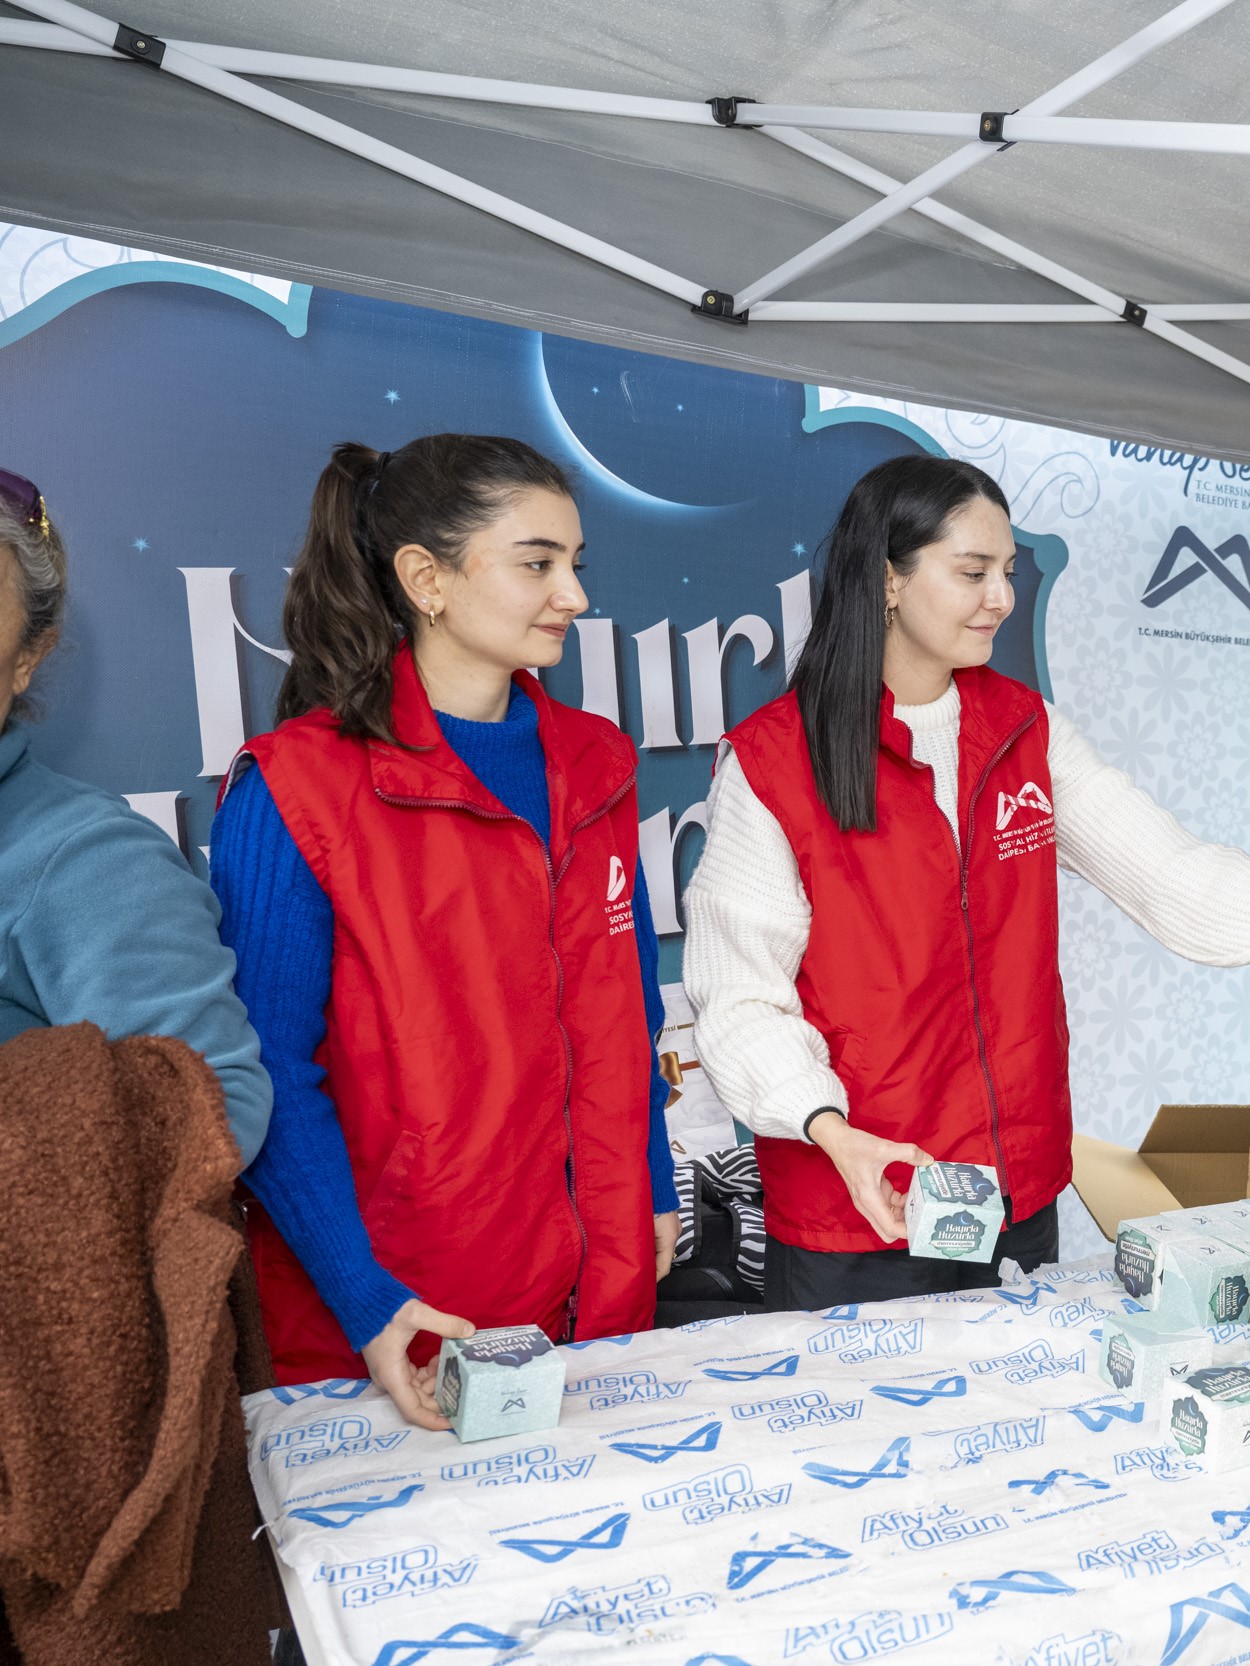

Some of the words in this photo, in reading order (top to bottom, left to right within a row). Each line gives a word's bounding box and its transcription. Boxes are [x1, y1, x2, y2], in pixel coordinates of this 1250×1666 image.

[1195, 493, 1239, 509] BELEDİYE
[1196, 479, 1214, 493] T.C.
[1215, 483, 1250, 498] MERSİN
[1138, 627, 1150, 636] T.C.
[1153, 629, 1183, 640] MERSİN
[1185, 631, 1232, 645] BÜYÜKŞEHİR
[938, 1231, 975, 1240] Huzurla
[945, 1223, 979, 1234] Hayırla
[473, 1333, 538, 1350] Huzurla
[474, 1341, 533, 1358] Hayırla
[811, 1319, 890, 1354] Olsun
[842, 1319, 921, 1363] Afiyet
[972, 1341, 1051, 1373] Olsun
[1007, 1353, 1082, 1383] Afiyet
[565, 1372, 656, 1394] Olsun
[1203, 1369, 1247, 1387] Hayırla
[595, 1380, 687, 1410] Afiyet
[735, 1392, 825, 1419] Olsun
[770, 1400, 860, 1432] Afiyet
[263, 1418, 367, 1455] Olsun
[290, 1431, 406, 1466] Afiyet
[957, 1417, 1043, 1457] Afiyet
[444, 1446, 552, 1480] Olsun
[647, 1467, 749, 1509] Olsun
[686, 1486, 788, 1523] Afiyet
[905, 1515, 1004, 1549] Olsun
[1081, 1531, 1173, 1569] Afiyet
[349, 1560, 475, 1604] Afiyet
